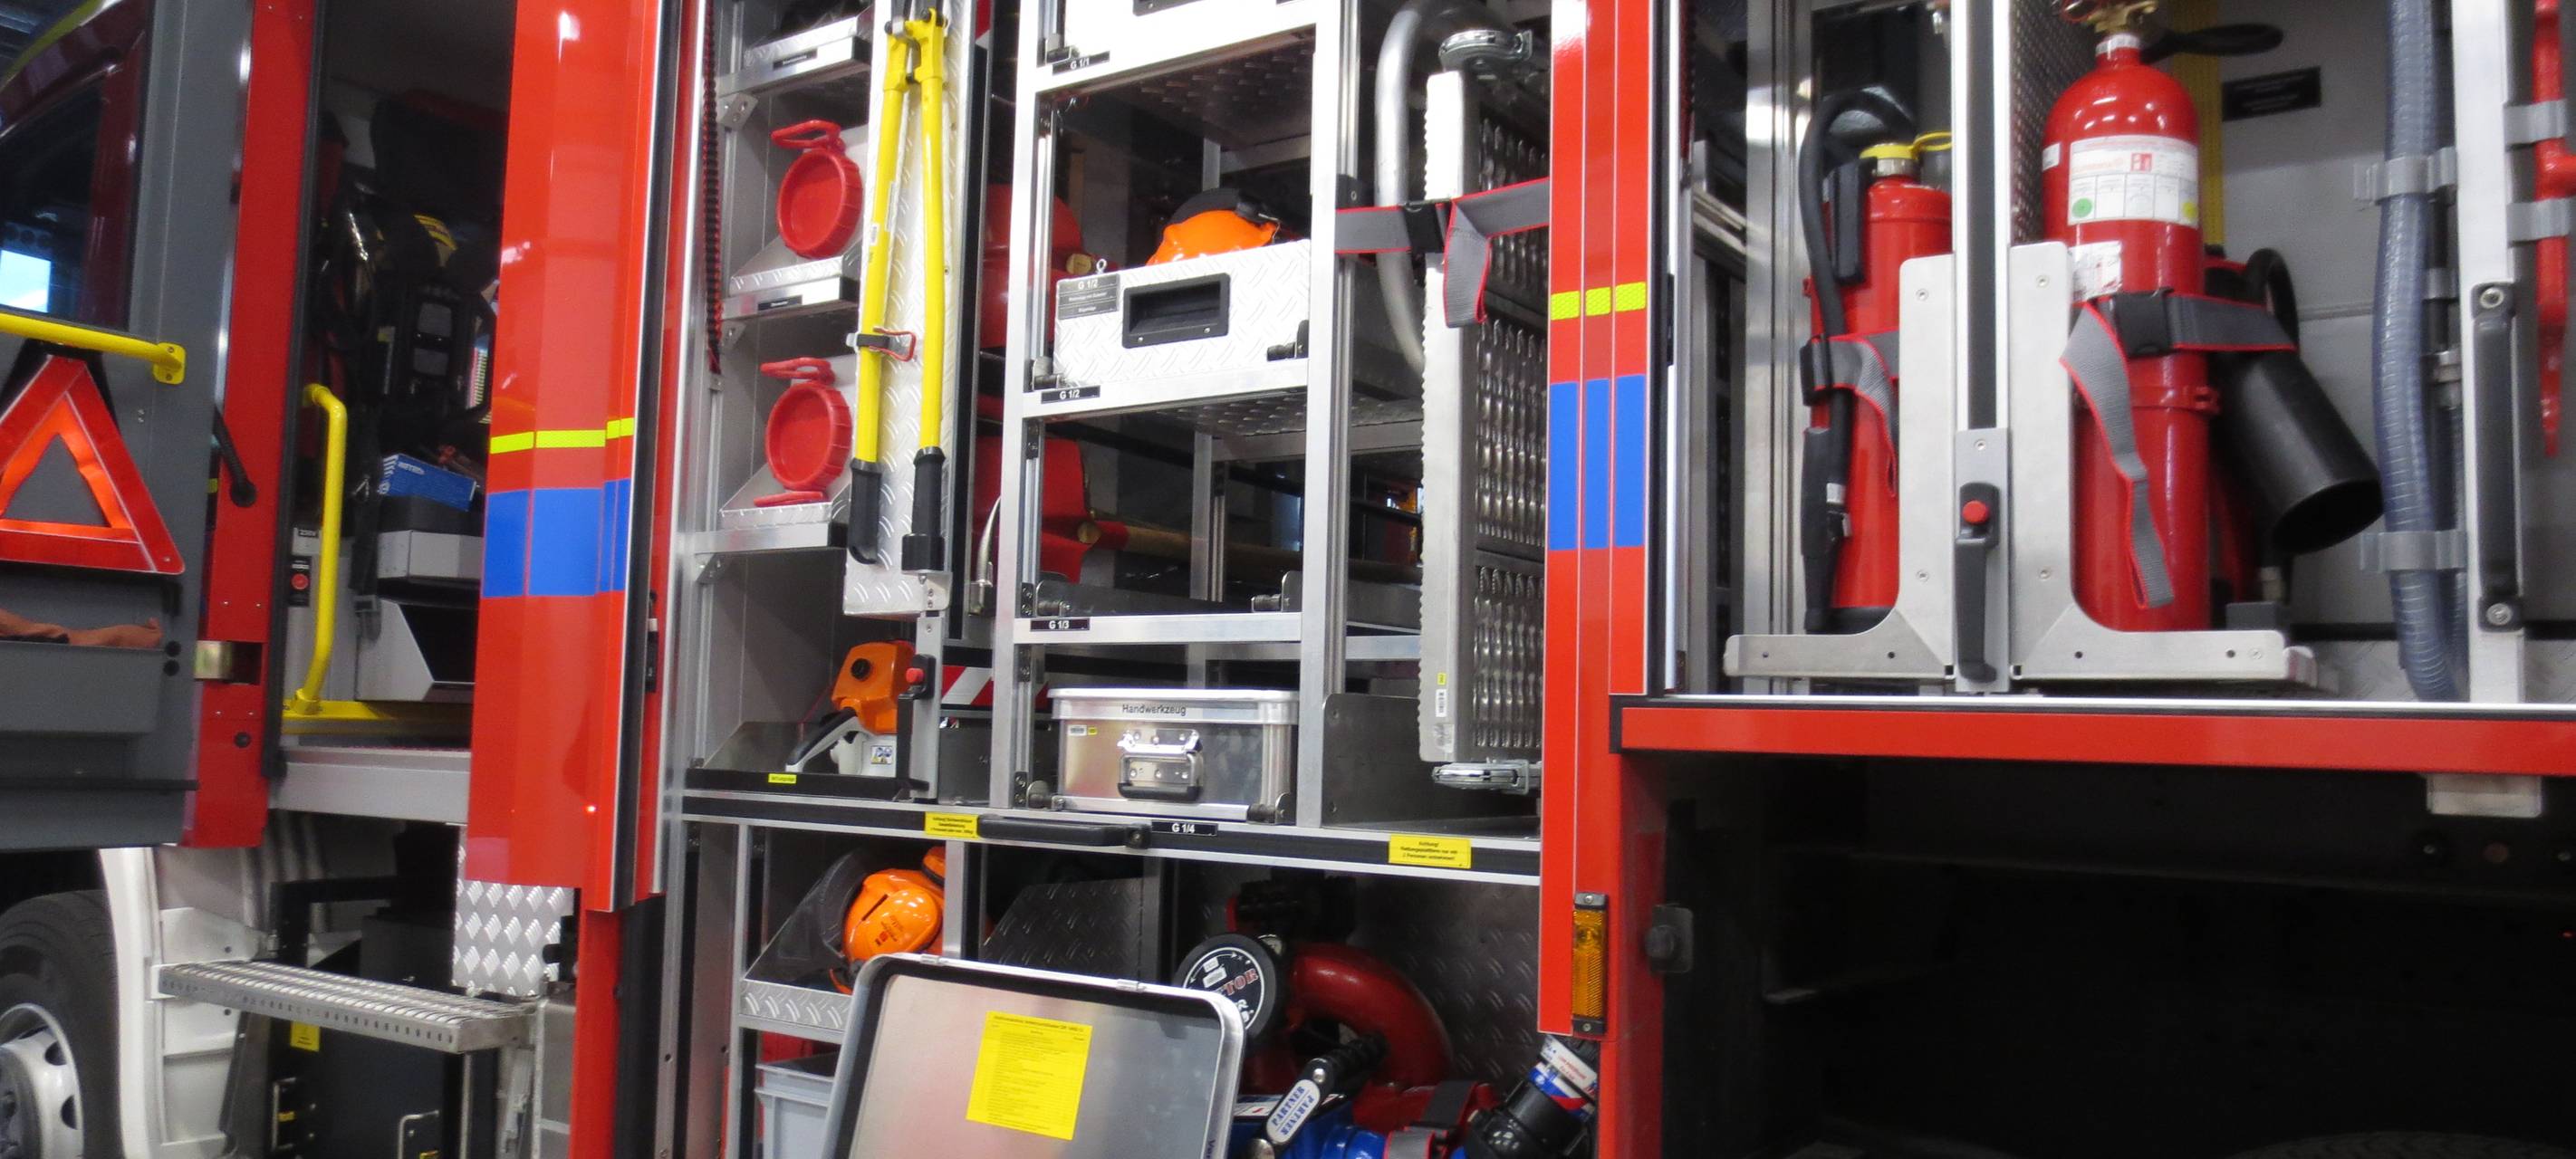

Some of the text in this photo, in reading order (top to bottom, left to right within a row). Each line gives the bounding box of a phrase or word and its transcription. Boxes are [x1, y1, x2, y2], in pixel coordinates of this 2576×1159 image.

[1070, 57, 1090, 70] G 1/1
[1078, 281, 1085, 290] G
[1059, 388, 1081, 399] G 1/2
[1049, 619, 1070, 629] G 1/3
[1121, 704, 1187, 716] Handwerkzeug
[1171, 822, 1196, 834] G 1/4
[1271, 1086, 1306, 1126] PARTNER
[1281, 1095, 1314, 1135] PARTNER
